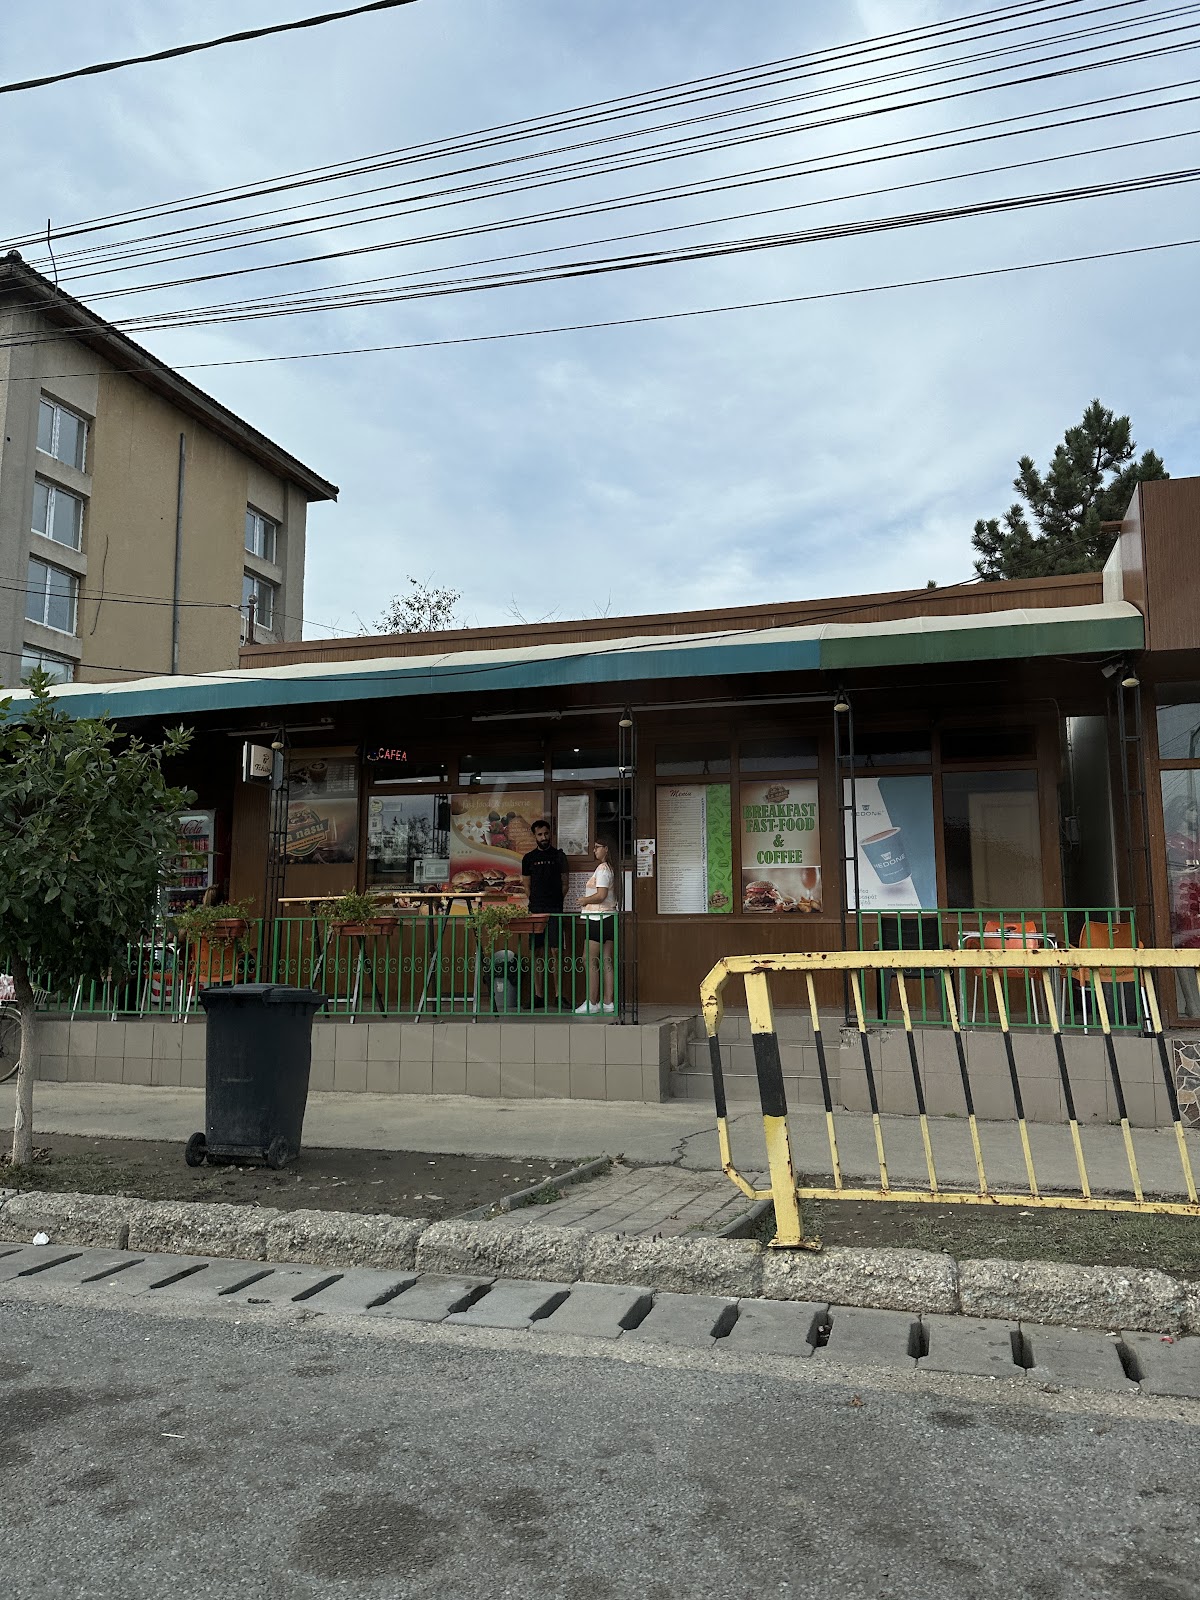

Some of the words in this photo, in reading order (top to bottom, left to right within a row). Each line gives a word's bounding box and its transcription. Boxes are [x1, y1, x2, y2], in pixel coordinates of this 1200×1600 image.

[378, 747, 407, 762] CAFEA
[742, 803, 816, 819] BREAKFAST
[296, 823, 325, 839] nasu
[746, 818, 815, 833] FAST-FOOD
[773, 833, 785, 848] &
[756, 849, 803, 865] COFFEE
[874, 853, 906, 869] HEDONE
